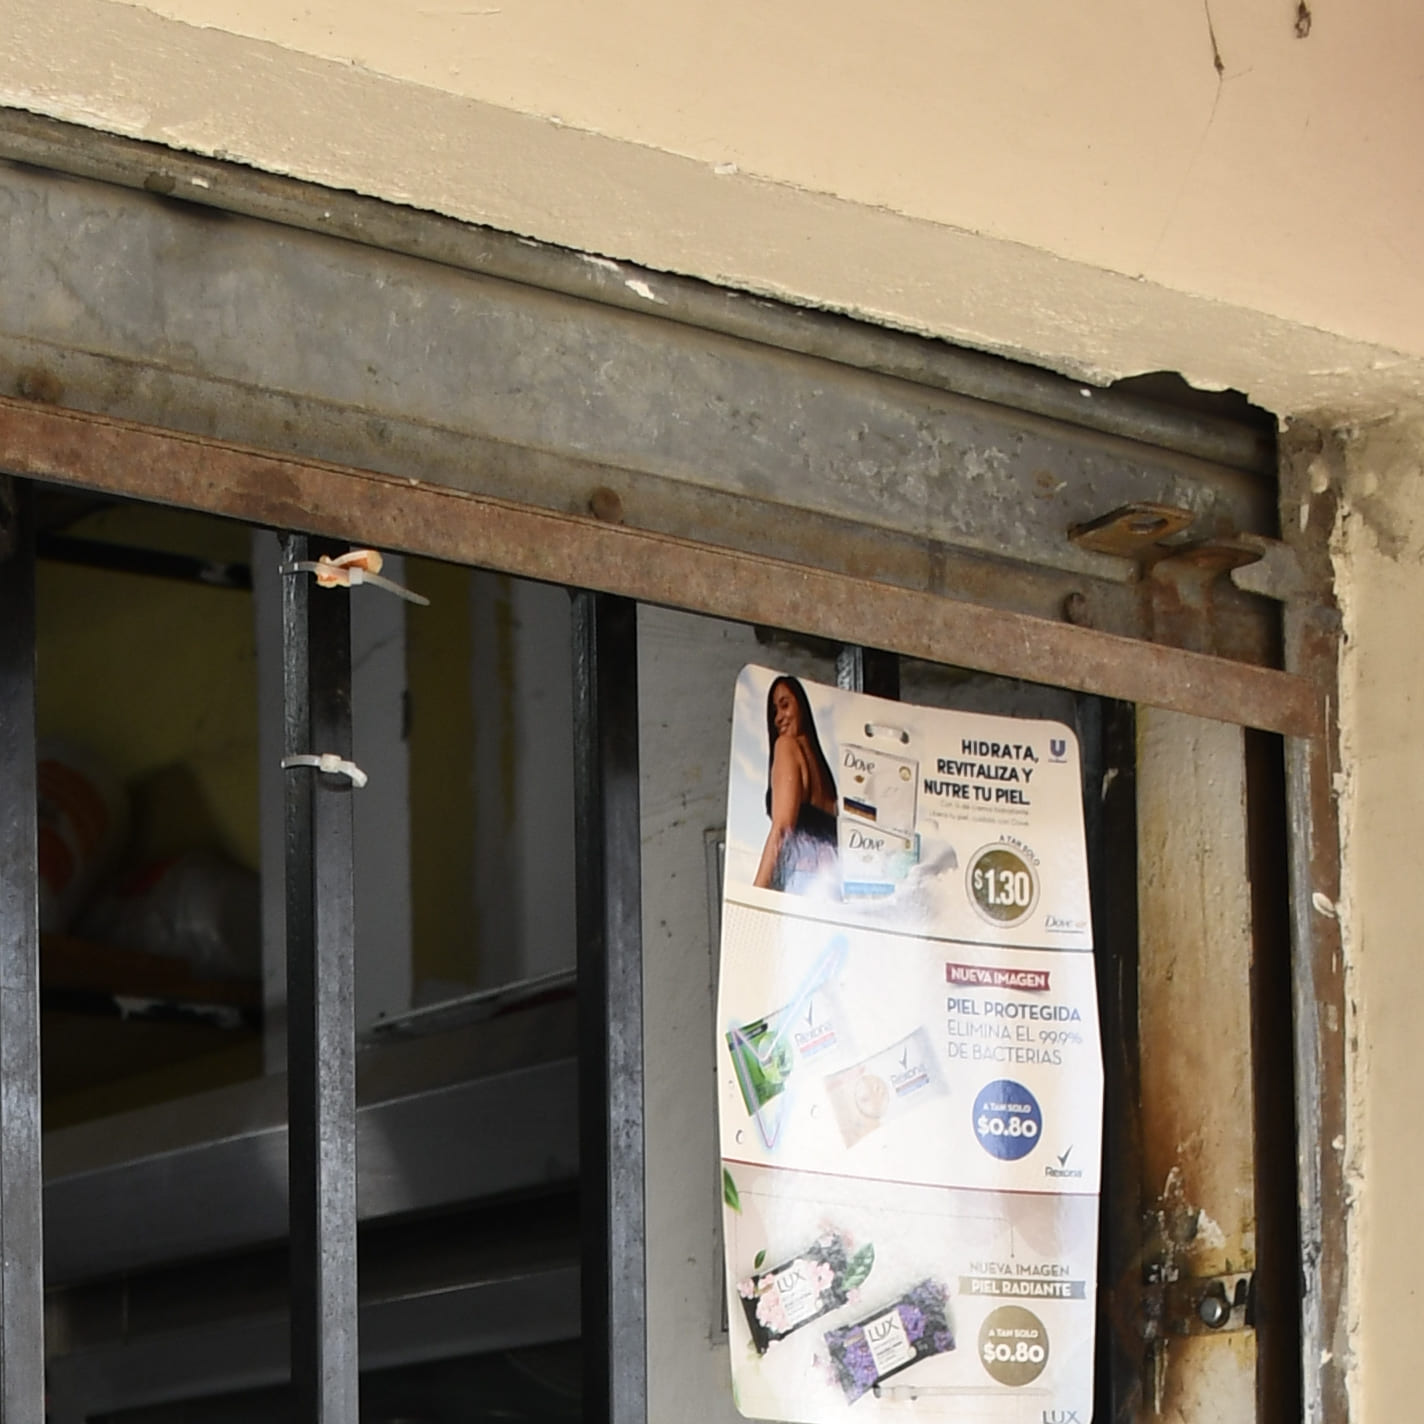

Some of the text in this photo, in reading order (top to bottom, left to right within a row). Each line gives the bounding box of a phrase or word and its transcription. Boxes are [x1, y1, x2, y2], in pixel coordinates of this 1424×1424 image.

[844, 751, 875, 774] Dove
[962, 739, 1039, 764] HIDRATA,
[937, 759, 1033, 783] REVITALIZA Y
[924, 779, 970, 800] NUTRE
[972, 786, 992, 802] TU
[848, 829, 885, 852] Dove
[975, 868, 1030, 907] $1.30
[1045, 915, 1072, 928] Dove
[951, 966, 1046, 988] NUEVA IMAGEN
[947, 997, 1082, 1022] PIEL PROTEGIDA
[947, 1019, 1012, 1041] ELIMINA
[1016, 1025, 1035, 1043] EL
[948, 1041, 1063, 1066] DE BACTERIAS
[977, 1115, 1037, 1138] $0.80
[1045, 1166, 1082, 1179] Rexona
[777, 1267, 805, 1294] LUX
[970, 1263, 1070, 1278] NUEVA IMAGEN
[971, 1279, 1072, 1298] PIEL RADIANTE
[867, 1316, 900, 1344] LUX
[983, 1341, 1045, 1364] $0.80
